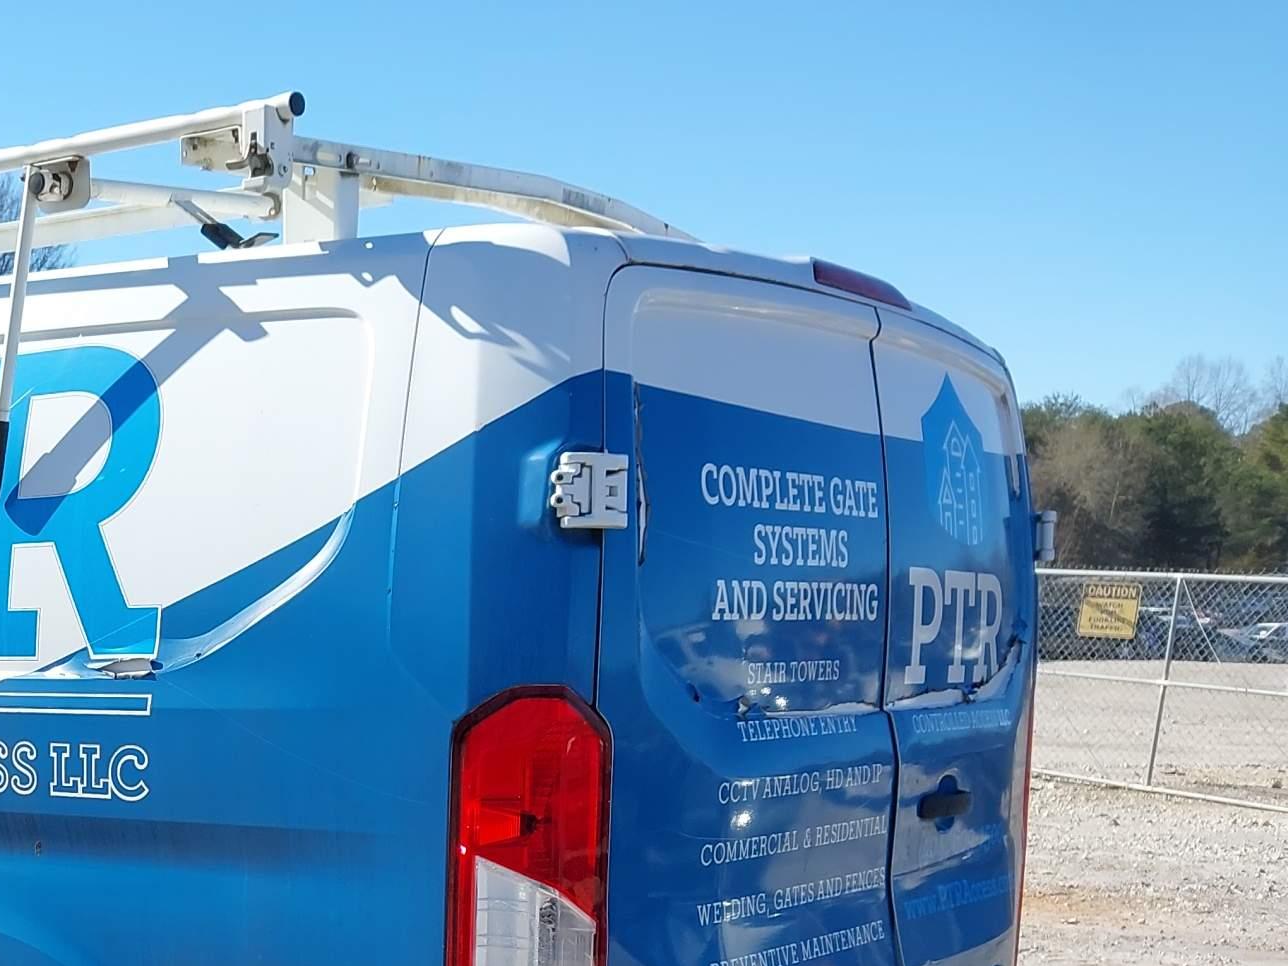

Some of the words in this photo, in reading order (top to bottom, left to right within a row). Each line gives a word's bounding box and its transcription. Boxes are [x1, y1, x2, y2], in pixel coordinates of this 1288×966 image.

[701, 463, 826, 513] COMPLETE
[830, 477, 879, 518] GATE
[754, 524, 849, 568] SYSTEMS
[712, 580, 768, 621] AND
[772, 581, 878, 621] SERVICING
[1088, 585, 1137, 598] CAUTION
[904, 566, 1003, 685] PTR
[747, 662, 787, 684] STAIR
[790, 660, 840, 682] TOWERS
[737, 717, 818, 742] TELEPHONE
[821, 715, 857, 736] ENTRY
[50, 743, 149, 801] LLC
[718, 779, 761, 804] CCTV
[762, 772, 823, 799] ANALOG,
[826, 768, 844, 790] HD
[846, 765, 871, 787] AND
[872, 764, 883, 783] IP
[700, 830, 799, 867] COMMERCIAL
[803, 828, 812, 848] &
[815, 815, 888, 847] RESIDENTIAL
[697, 893, 770, 927] WELDING,
[774, 882, 815, 910] GATES
[816, 876, 843, 900] AND
[844, 866, 885, 895] FENCES
[800, 920, 885, 962] MAINTENANCE
